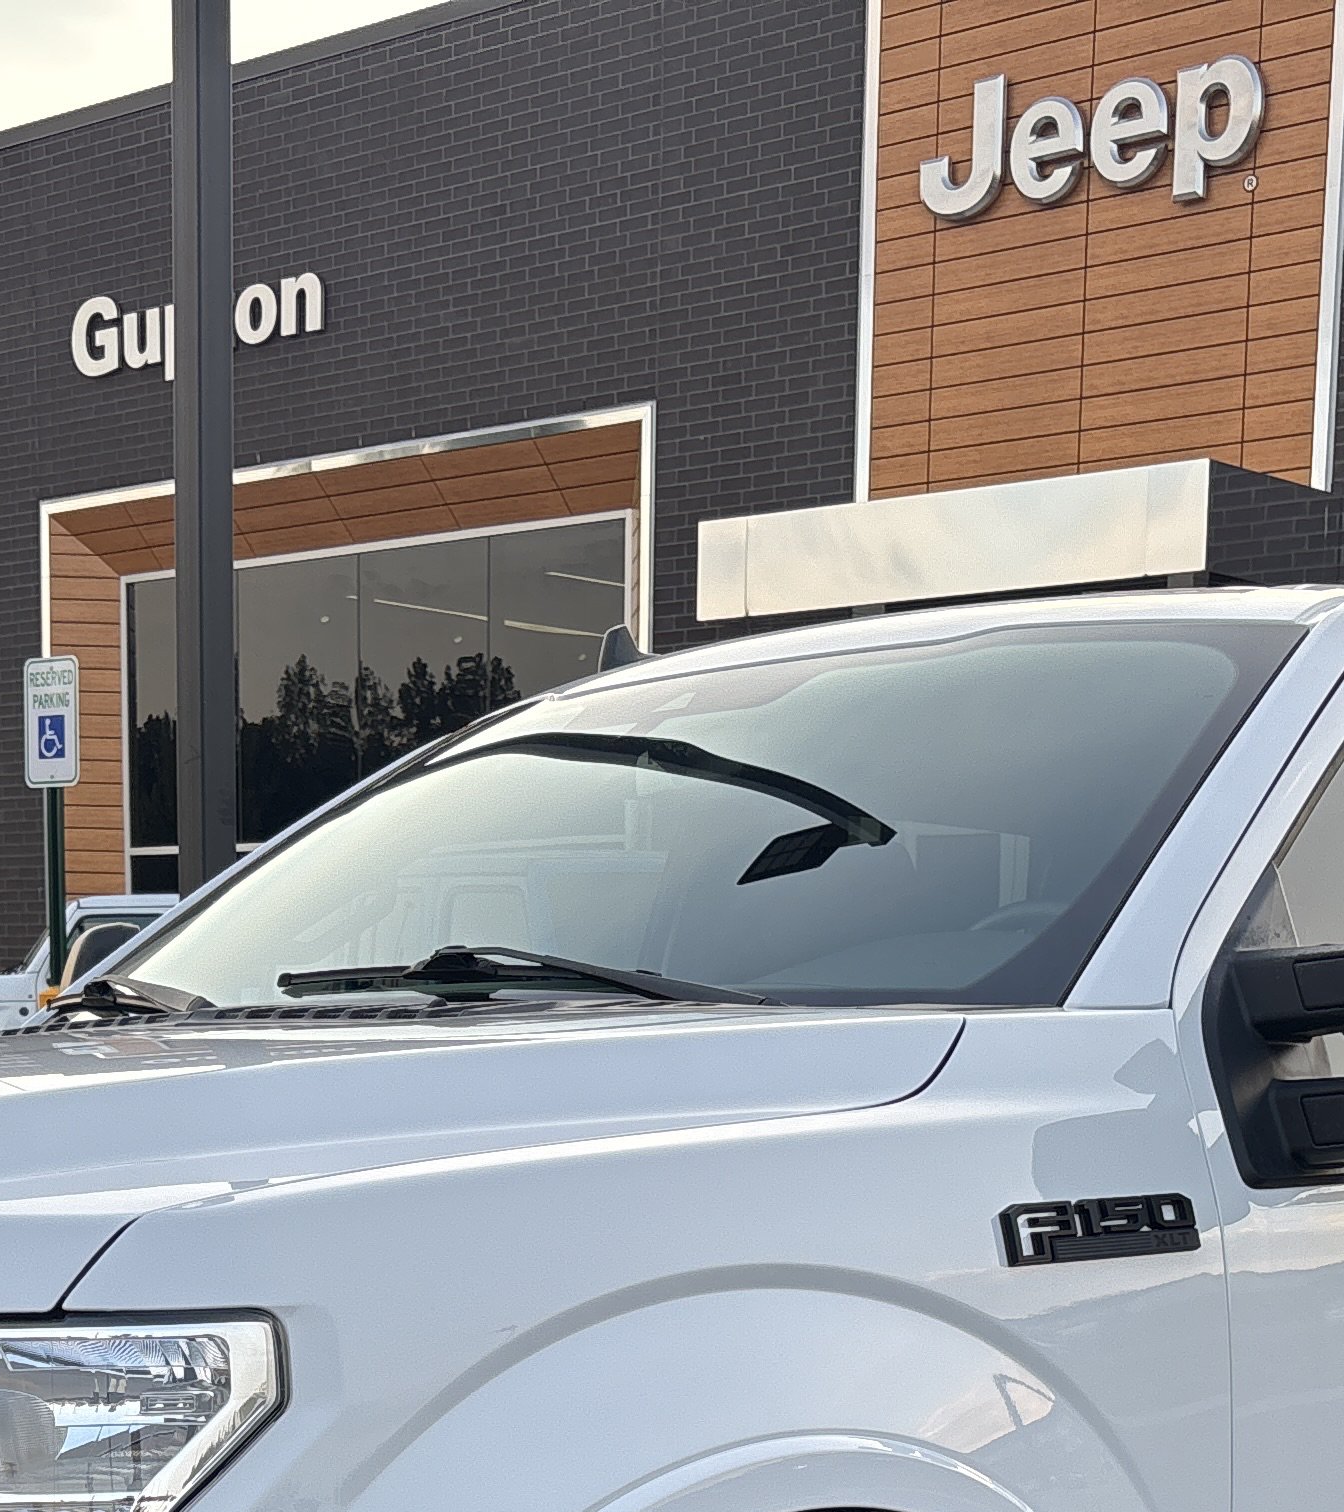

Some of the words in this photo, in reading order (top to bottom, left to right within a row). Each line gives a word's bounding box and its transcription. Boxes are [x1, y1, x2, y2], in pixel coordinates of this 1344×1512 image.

[919, 54, 1265, 220] Jeep
[71, 272, 325, 382] Guon
[29, 669, 73, 688] RESERVED
[32, 692, 70, 710] PARKING
[1153, 1231, 1192, 1249] XLT
